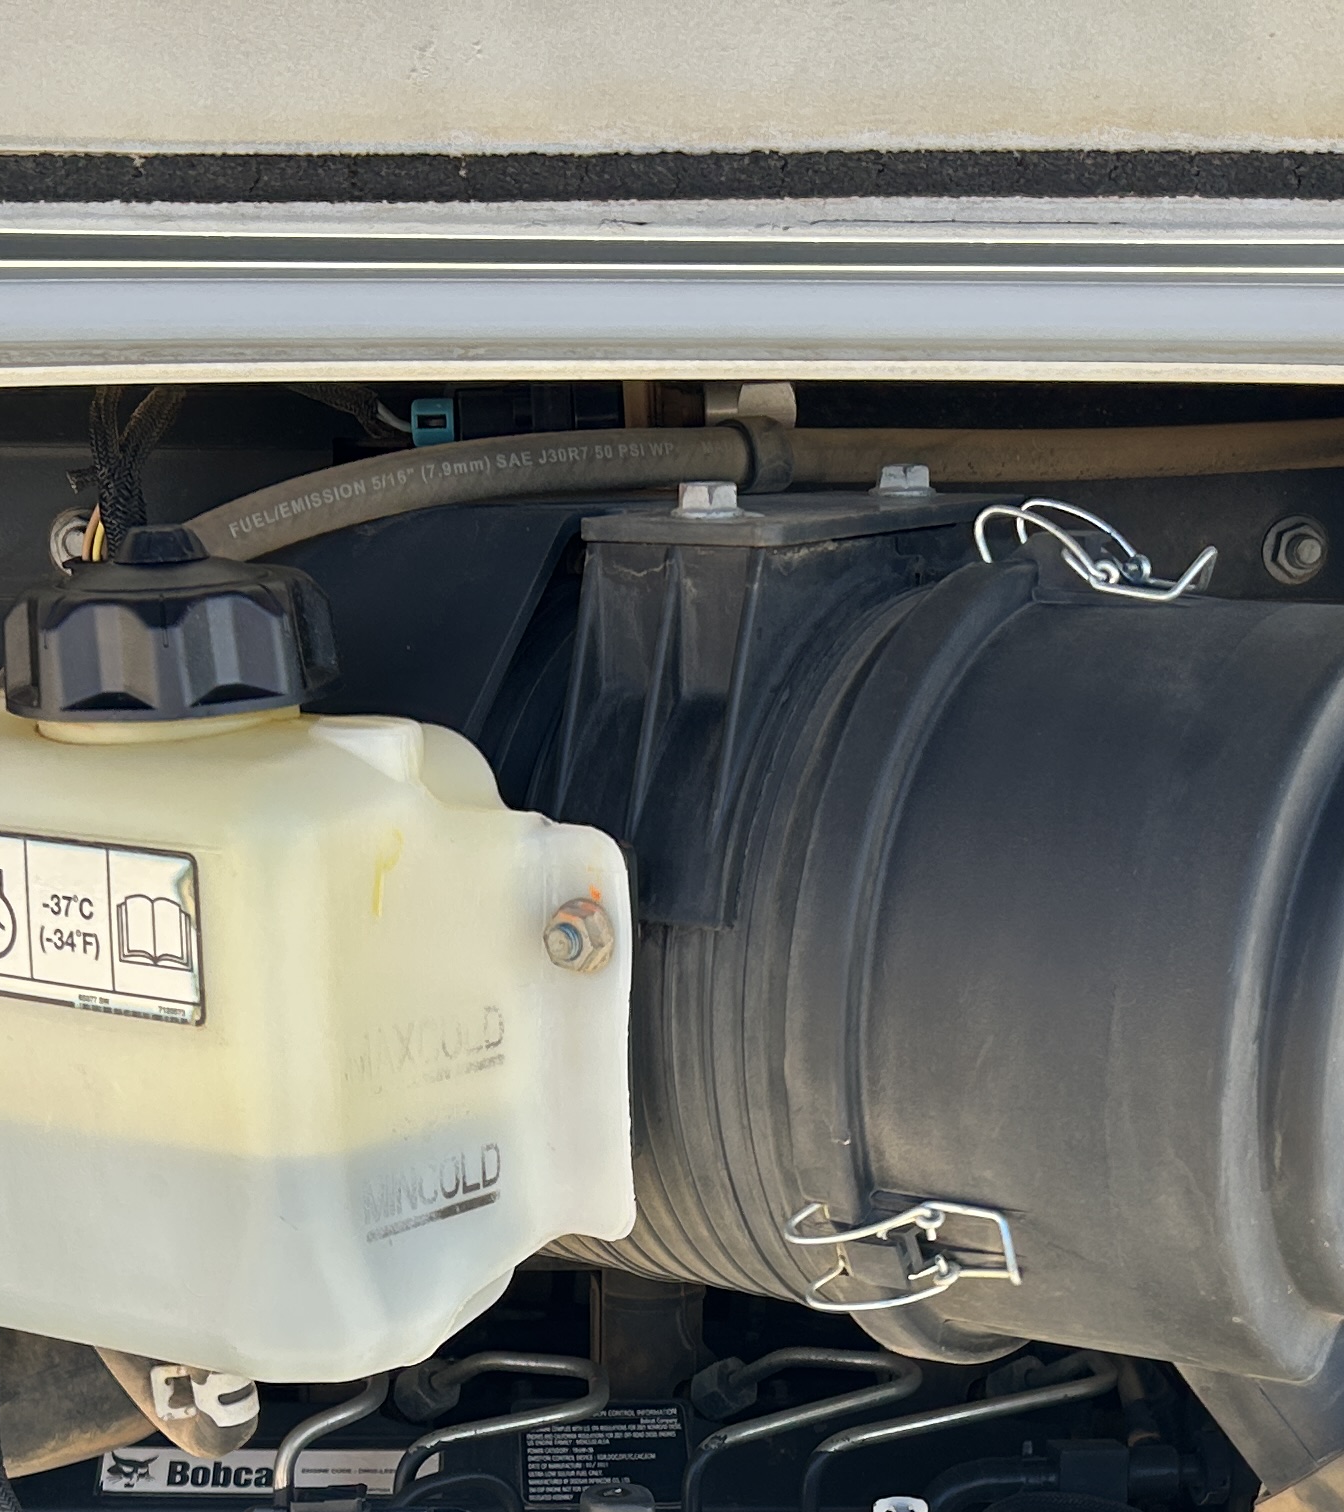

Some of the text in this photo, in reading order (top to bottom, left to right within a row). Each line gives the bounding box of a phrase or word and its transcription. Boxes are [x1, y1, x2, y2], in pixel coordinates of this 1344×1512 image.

[229, 480, 367, 538] FUEL/EMISSION
[421, 455, 491, 484] (7.9mm)
[496, 454, 534, 468] SAE
[539, 446, 589, 464] J30R7
[595, 445, 612, 459] 50
[618, 443, 645, 457] PSI
[166, 1459, 274, 1488] Bobca
